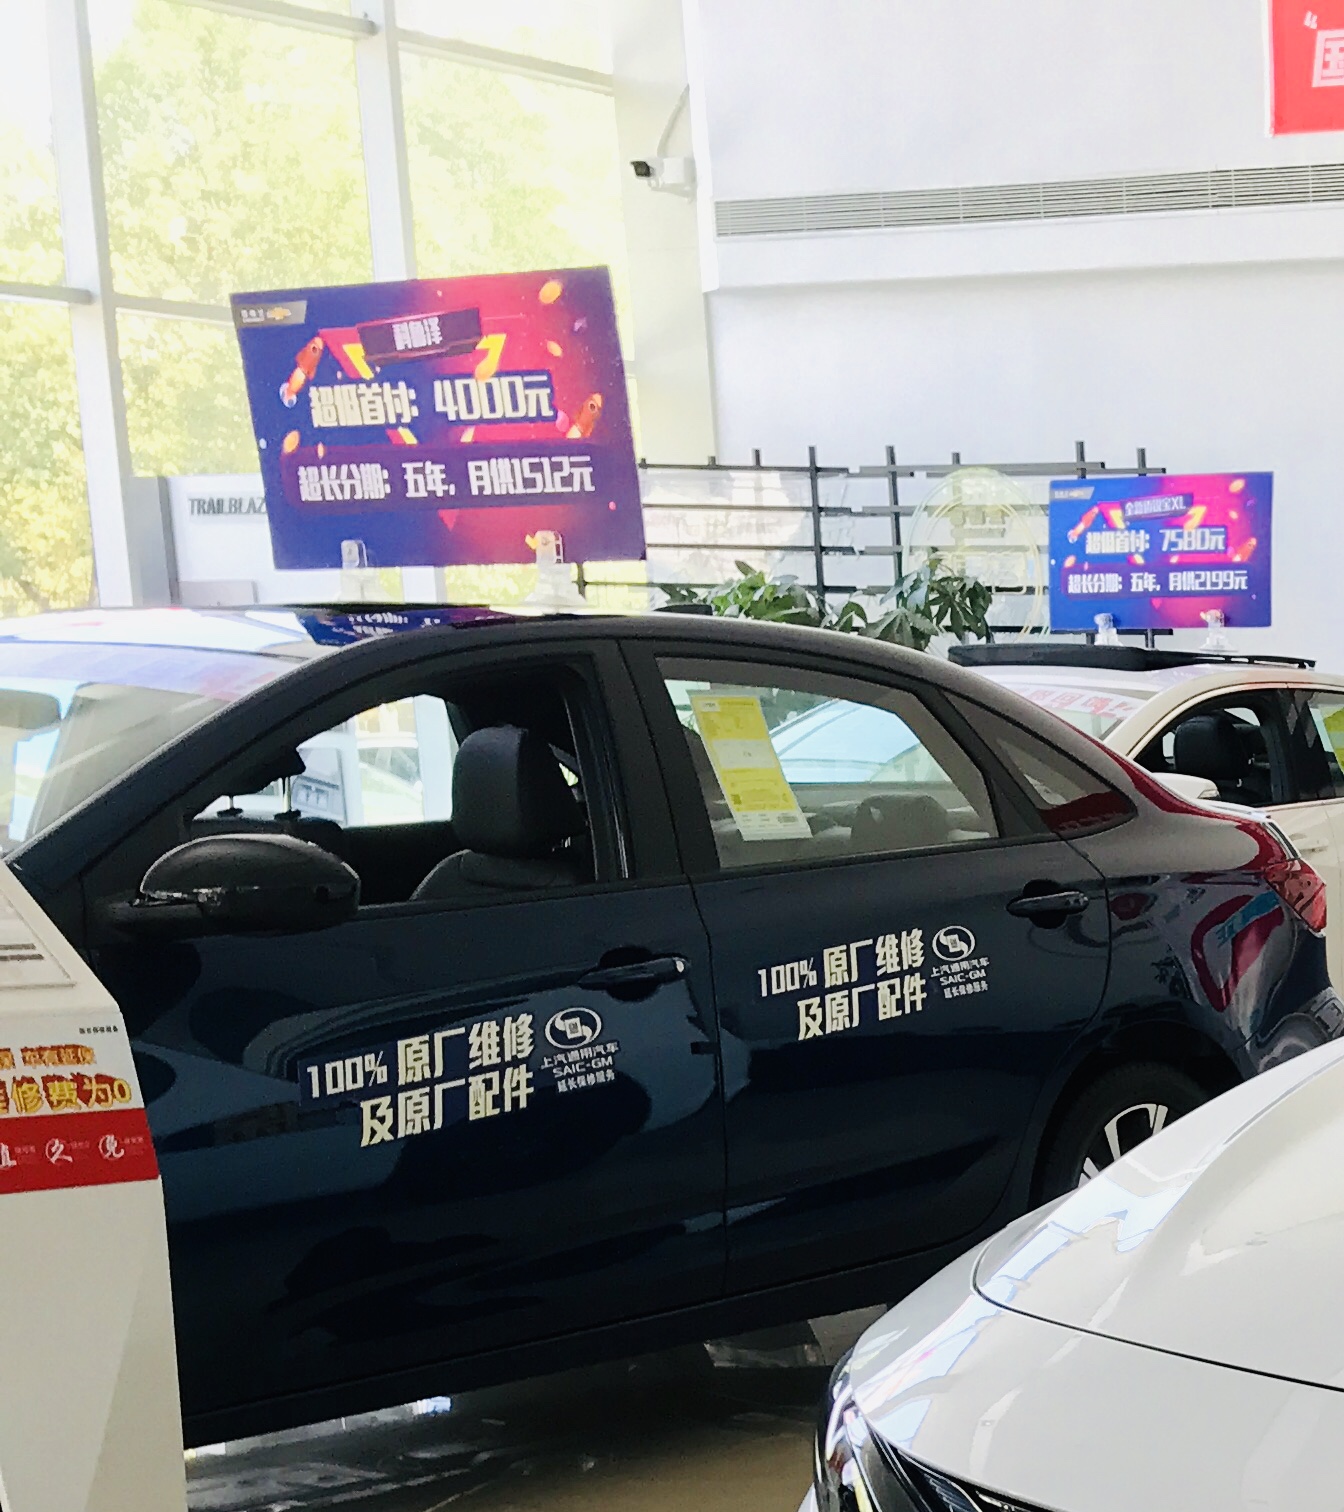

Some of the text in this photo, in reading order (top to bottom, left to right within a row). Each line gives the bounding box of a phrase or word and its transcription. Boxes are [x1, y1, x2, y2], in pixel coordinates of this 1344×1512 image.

[434, 375, 554, 421] 4000元
[797, 972, 928, 1041] 及原厂配件
[360, 1063, 535, 1148] 及原厂配件
